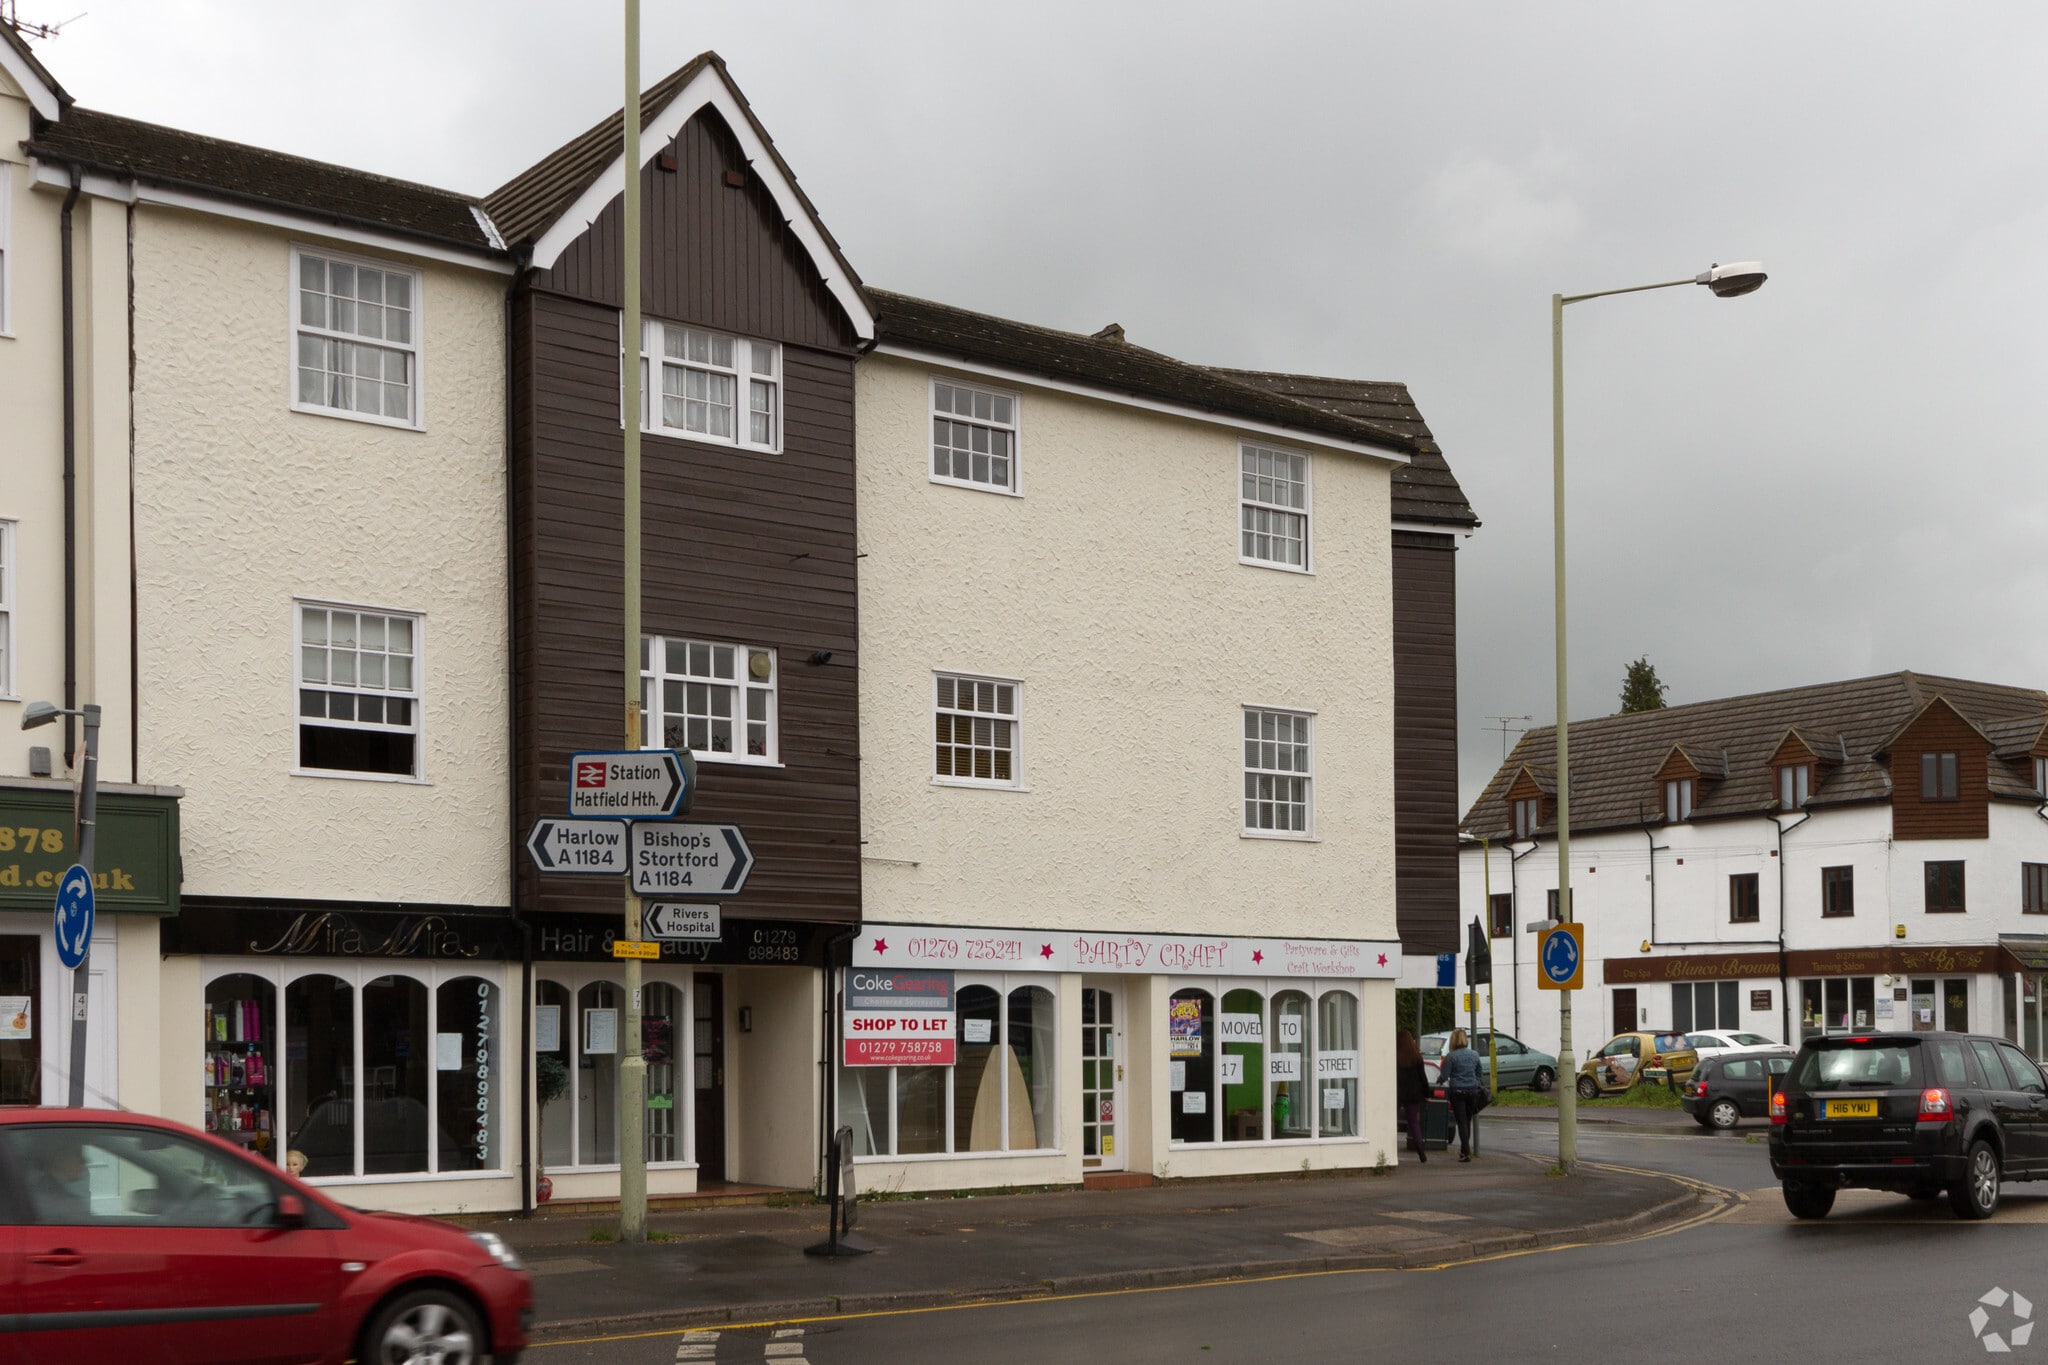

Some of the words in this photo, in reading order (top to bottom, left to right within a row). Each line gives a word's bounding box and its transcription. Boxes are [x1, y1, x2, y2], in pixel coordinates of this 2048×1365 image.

[610, 765, 660, 780] Station
[575, 791, 628, 807] Hatfield
[632, 791, 659, 806] Hth.
[557, 828, 619, 845] Harlow
[644, 832, 711, 850] Bishop's
[558, 851, 571, 864] A
[575, 850, 614, 865] 1184
[639, 851, 718, 867] Stortford
[639, 871, 651, 885] A
[656, 871, 693, 886] 1184
[673, 908, 709, 919] Rivers
[667, 921, 715, 934] Hospital
[541, 928, 593, 951] Hair
[754, 929, 796, 944] 01279
[748, 946, 799, 961] 898483
[908, 938, 958, 959] 01279
[966, 939, 1022, 960] 725241
[1074, 937, 1152, 969] PARTY
[1159, 941, 1228, 970] CRAFT
[1330, 944, 1337, 956] &
[1340, 945, 1360, 958] Gifts
[1287, 961, 1308, 974] Craft
[1312, 961, 1355, 976] Workshop
[1665, 960, 1717, 978] Blanco
[1720, 959, 1780, 976] Browns
[1812, 962, 1842, 973] Tanning
[1844, 961, 1865, 971] Salon
[853, 1018, 896, 1031] SHOP
[900, 1018, 918, 1031] TO
[923, 1018, 947, 1031] LET
[1221, 1021, 1263, 1035] MOVED
[1281, 1023, 1297, 1036] TO
[860, 1042, 896, 1053] 01279
[901, 1042, 942, 1053] 758758
[1221, 1063, 1237, 1076] 17
[1271, 1060, 1294, 1074] BELL
[1318, 1058, 1354, 1072] STREET
[1833, 1104, 1849, 1113] H16
[1851, 1103, 1871, 1113] YMU
